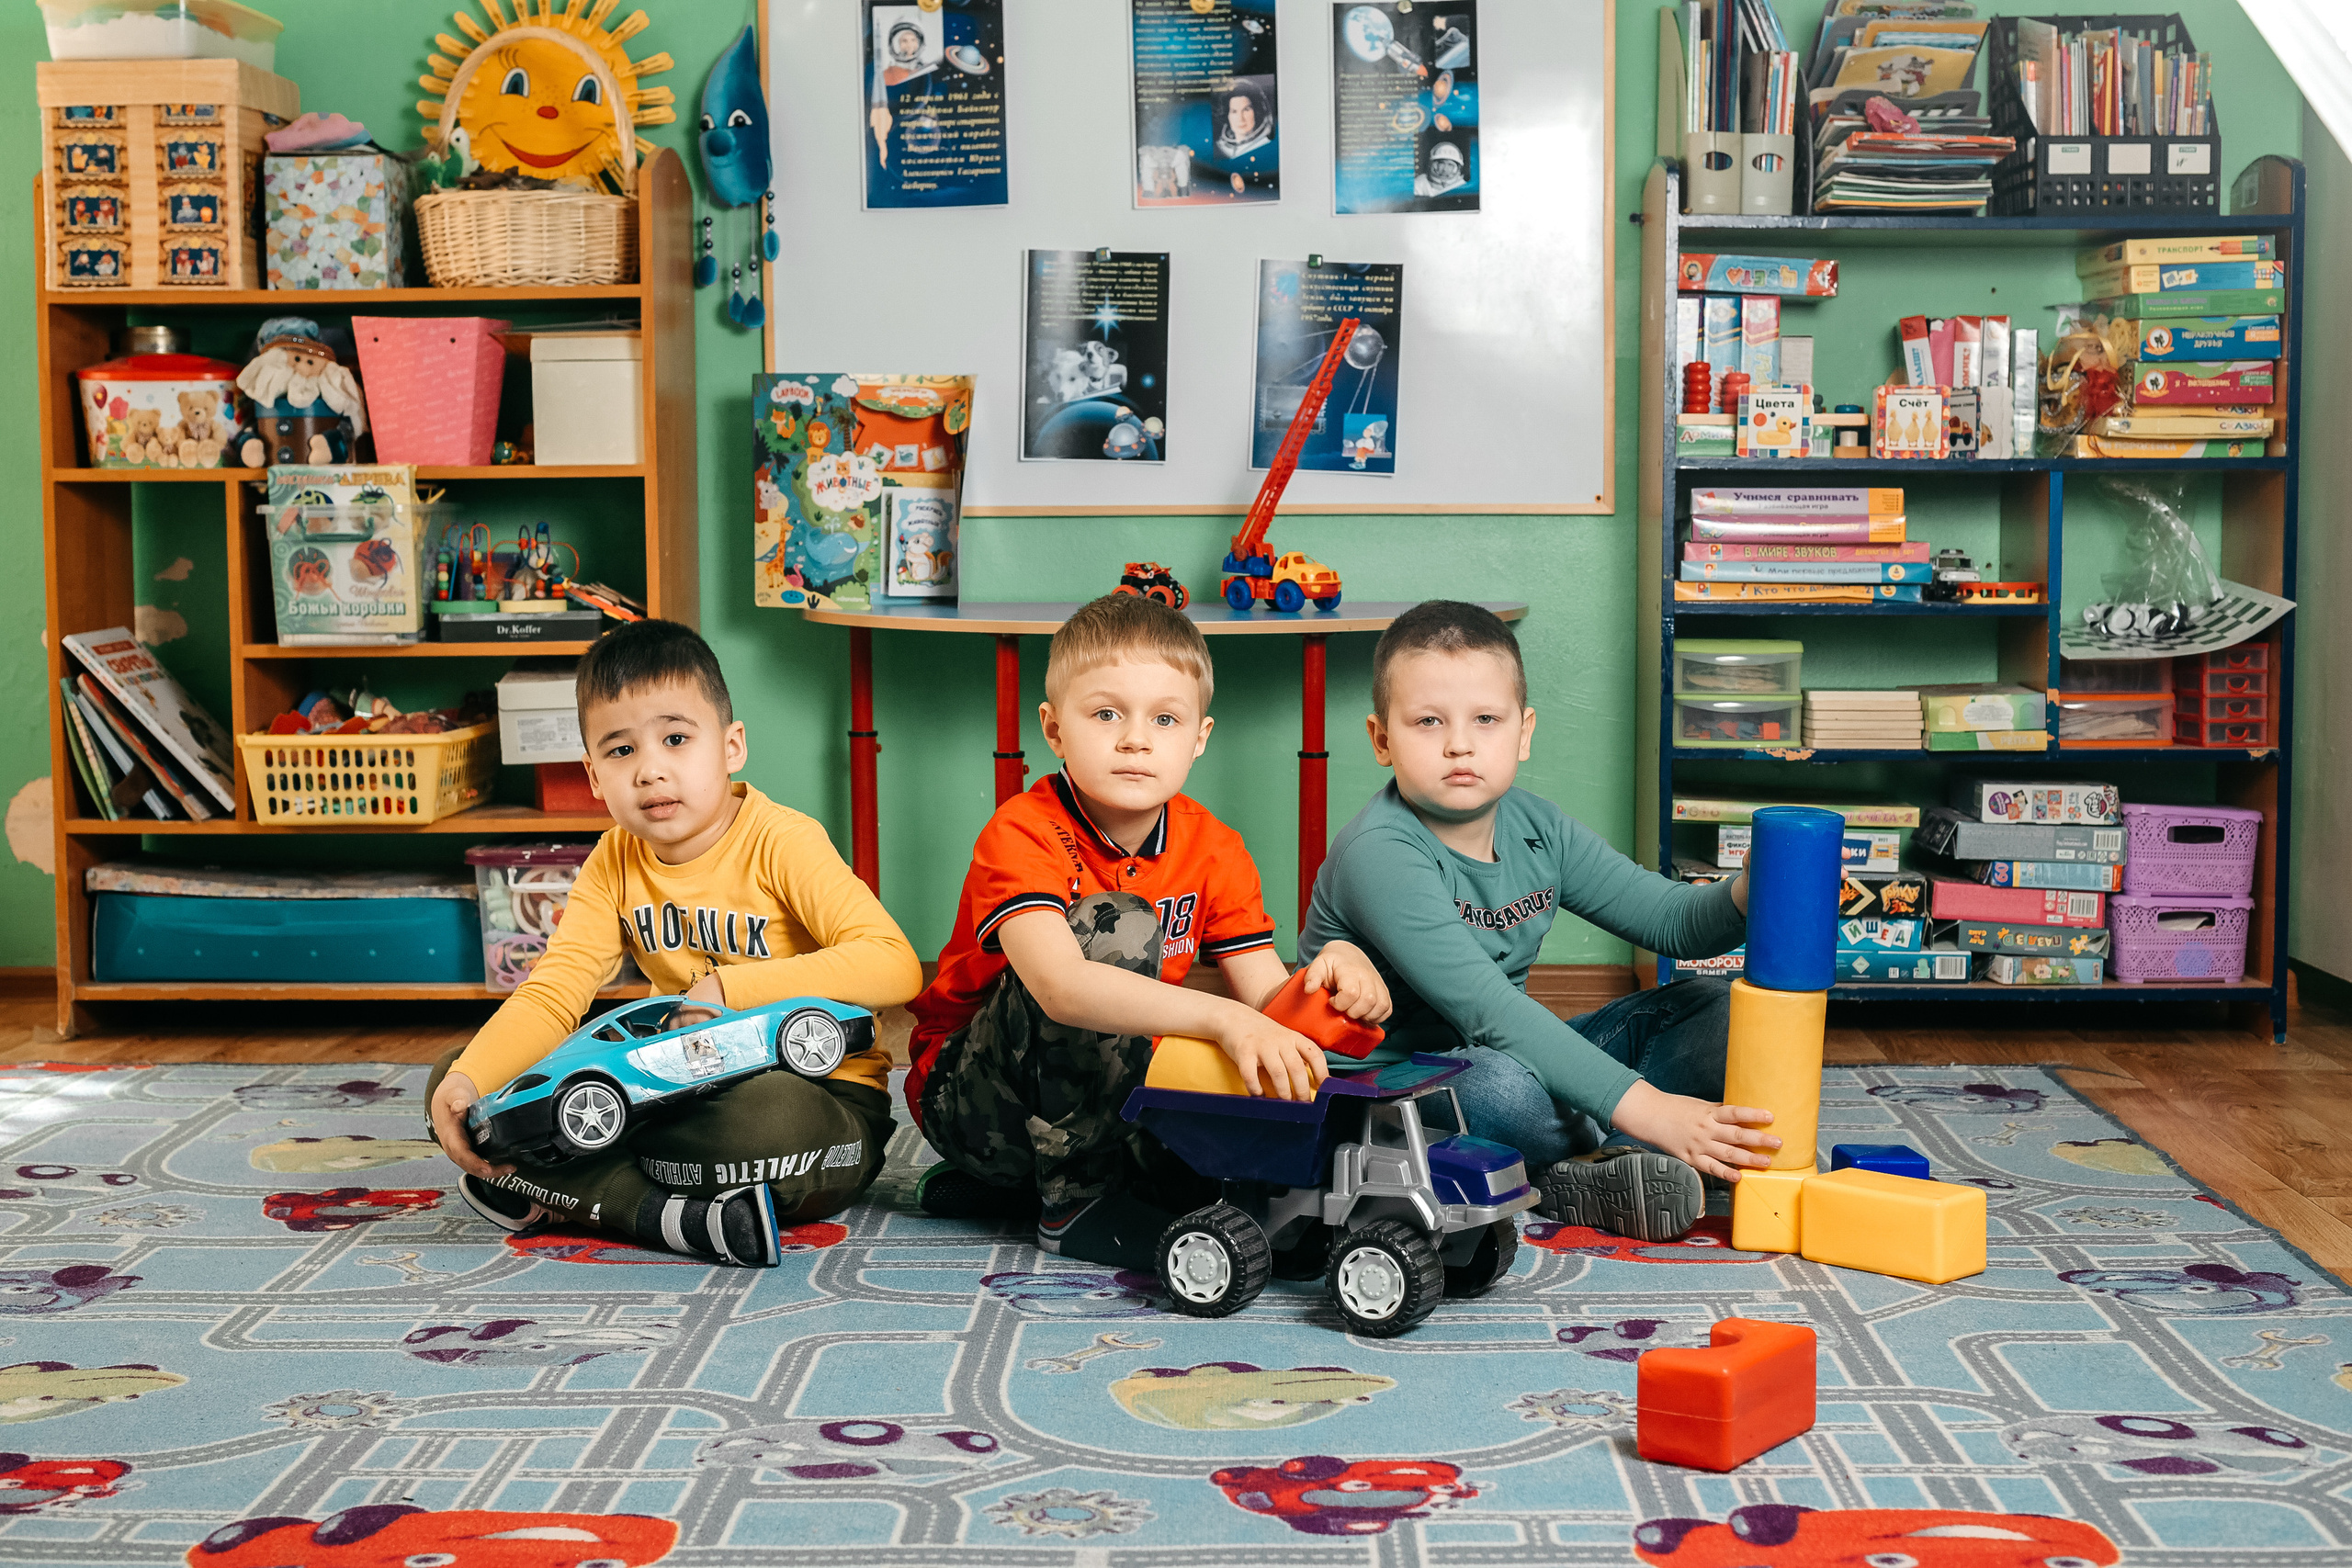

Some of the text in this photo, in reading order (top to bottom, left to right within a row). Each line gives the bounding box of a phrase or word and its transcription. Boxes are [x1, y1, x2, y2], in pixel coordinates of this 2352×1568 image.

[2157, 245, 2203, 254] ТРАНСПОРТ
[1756, 399, 1794, 409] Цвета
[1899, 398, 1929, 408] Счёт
[1734, 492, 1860, 503] Учимся сравнивать
[1744, 547, 1838, 558] В МИРЕ ЗВУКОВ
[1753, 586, 1778, 596] Кто
[288, 601, 406, 618] Божьи коровки
[1156, 892, 1198, 942] 18
[1679, 957, 1745, 968] MONOPOLY
[715, 1148, 822, 1184] ATHLETIC
